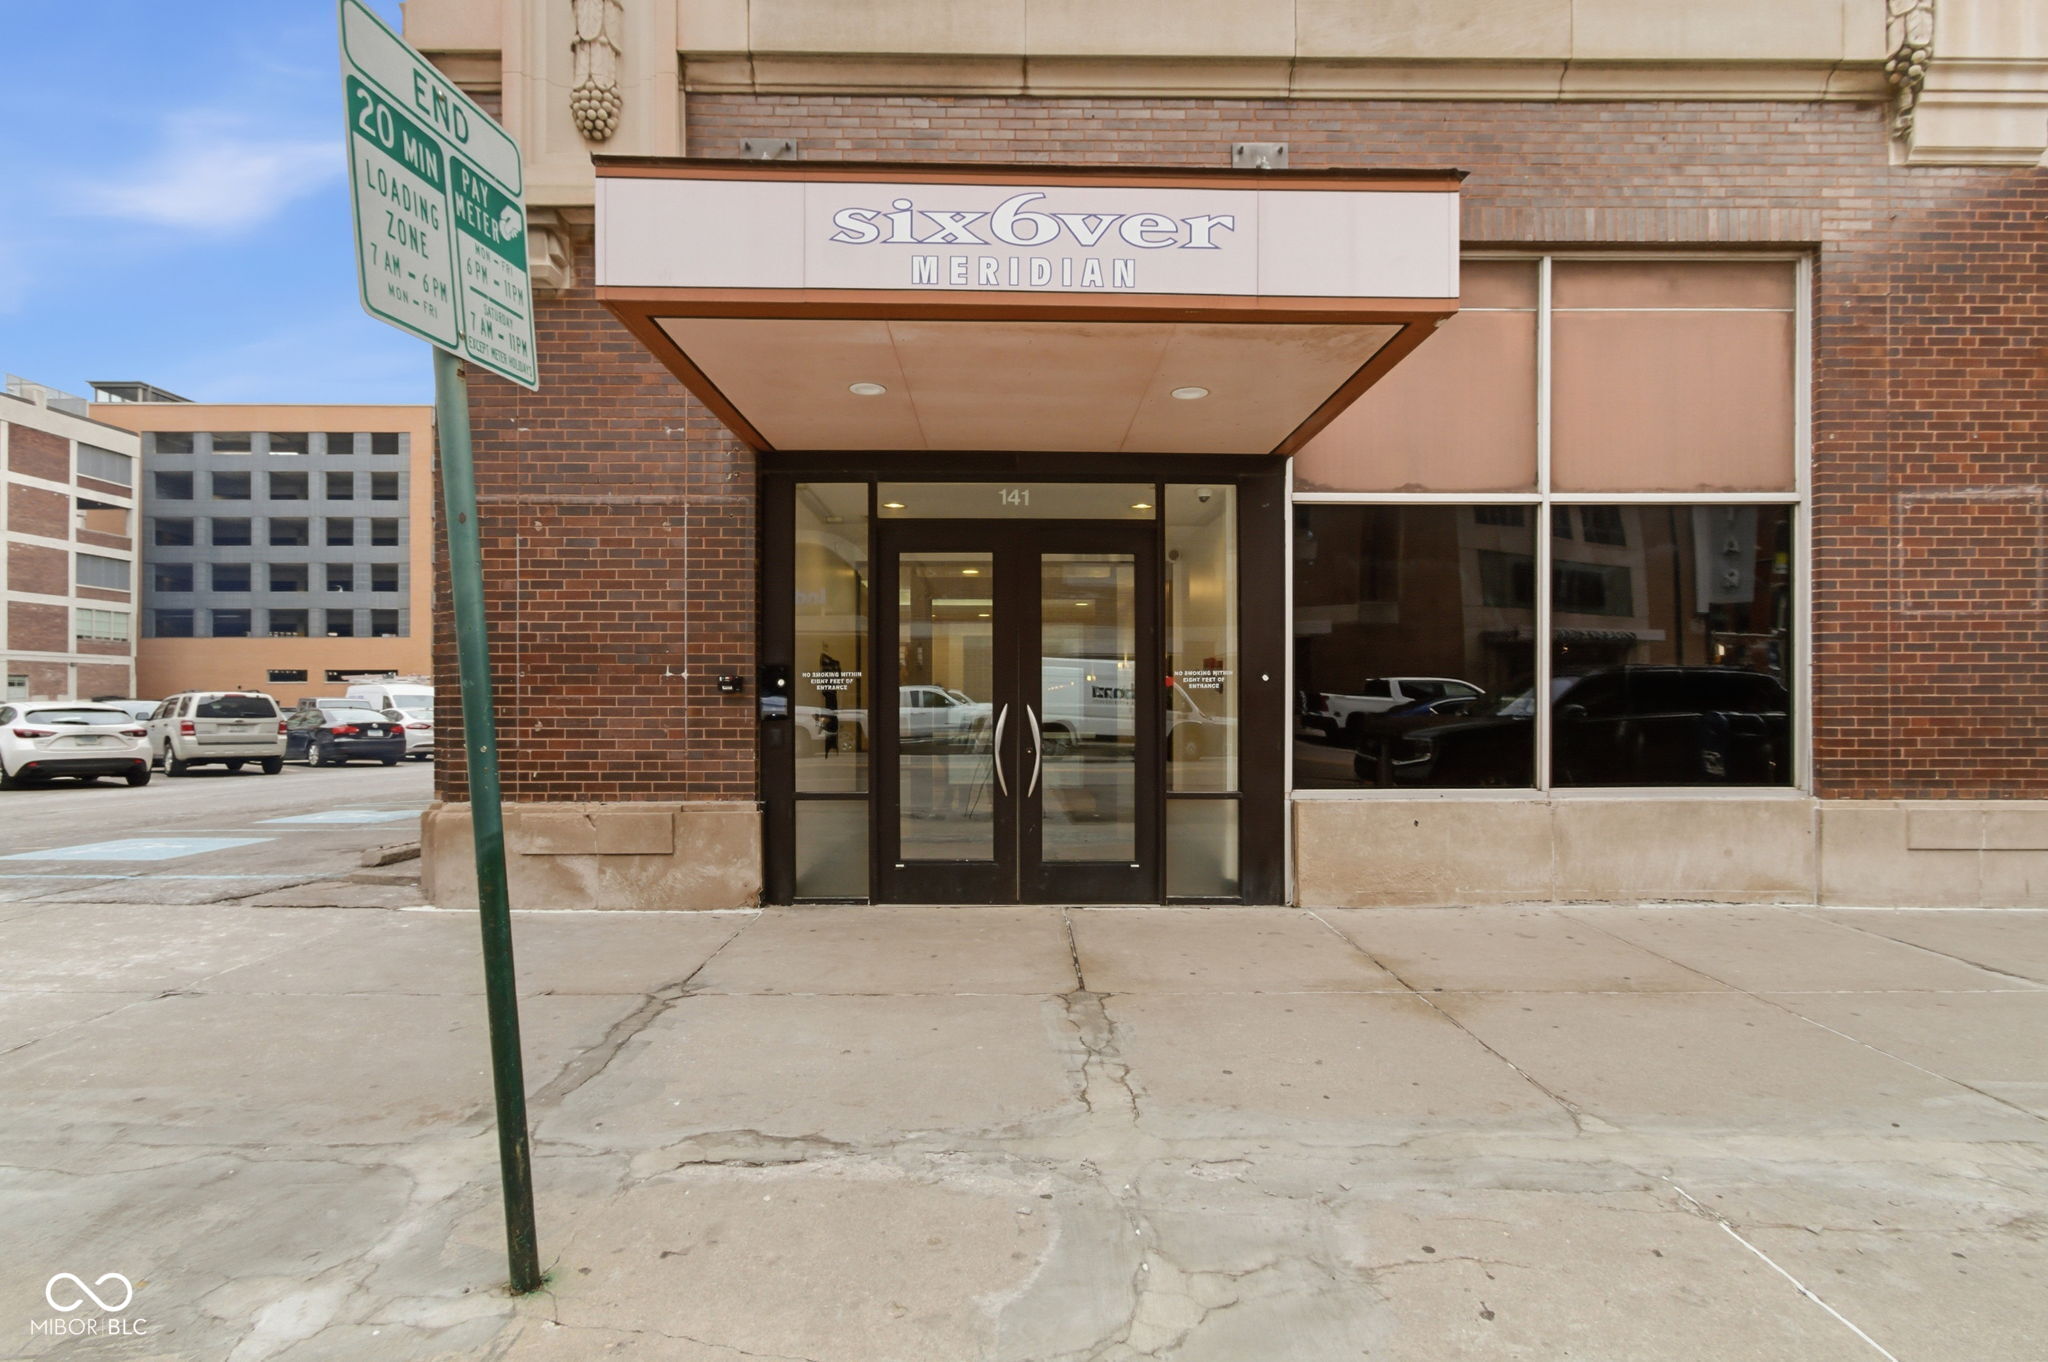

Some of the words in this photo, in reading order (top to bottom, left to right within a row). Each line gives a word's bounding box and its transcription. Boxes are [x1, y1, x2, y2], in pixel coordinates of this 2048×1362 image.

[412, 67, 469, 145] END
[356, 87, 395, 149] 20
[402, 130, 439, 184] MIN
[365, 158, 439, 231] LOADING
[461, 168, 489, 208] PAY
[385, 209, 430, 260] ZONE
[454, 191, 500, 244] METER
[829, 192, 1236, 250] six6ver
[911, 255, 1136, 289] MERIDIAN
[483, 303, 513, 329] SATURDAY
[998, 488, 1030, 506] 141
